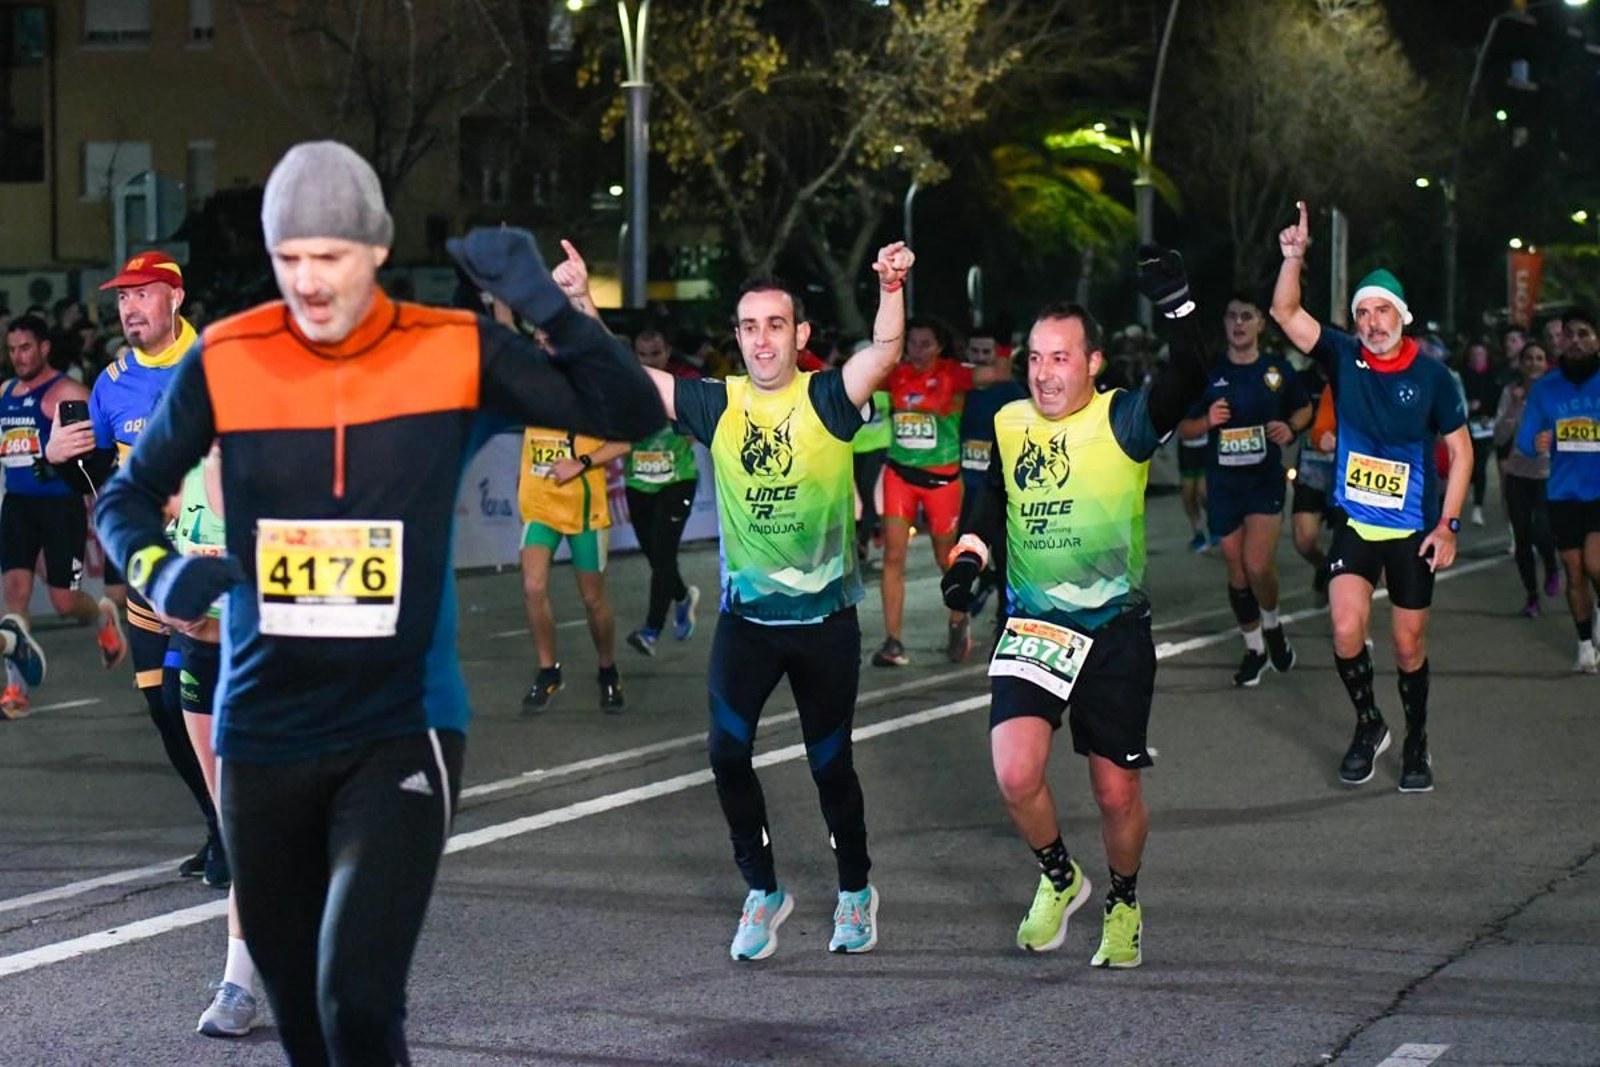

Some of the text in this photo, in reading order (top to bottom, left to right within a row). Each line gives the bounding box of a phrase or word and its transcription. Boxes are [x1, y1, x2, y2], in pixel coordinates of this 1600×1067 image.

[1560, 426, 1597, 439] 4201
[1220, 437, 1260, 452] 2053
[1350, 468, 1401, 492] 4105
[745, 485, 798, 501] LINCE
[1020, 500, 1074, 517] LINCE
[1023, 536, 1081, 550] ANDÚJAR
[269, 556, 386, 591] 4176
[1001, 635, 1073, 674] 2675
